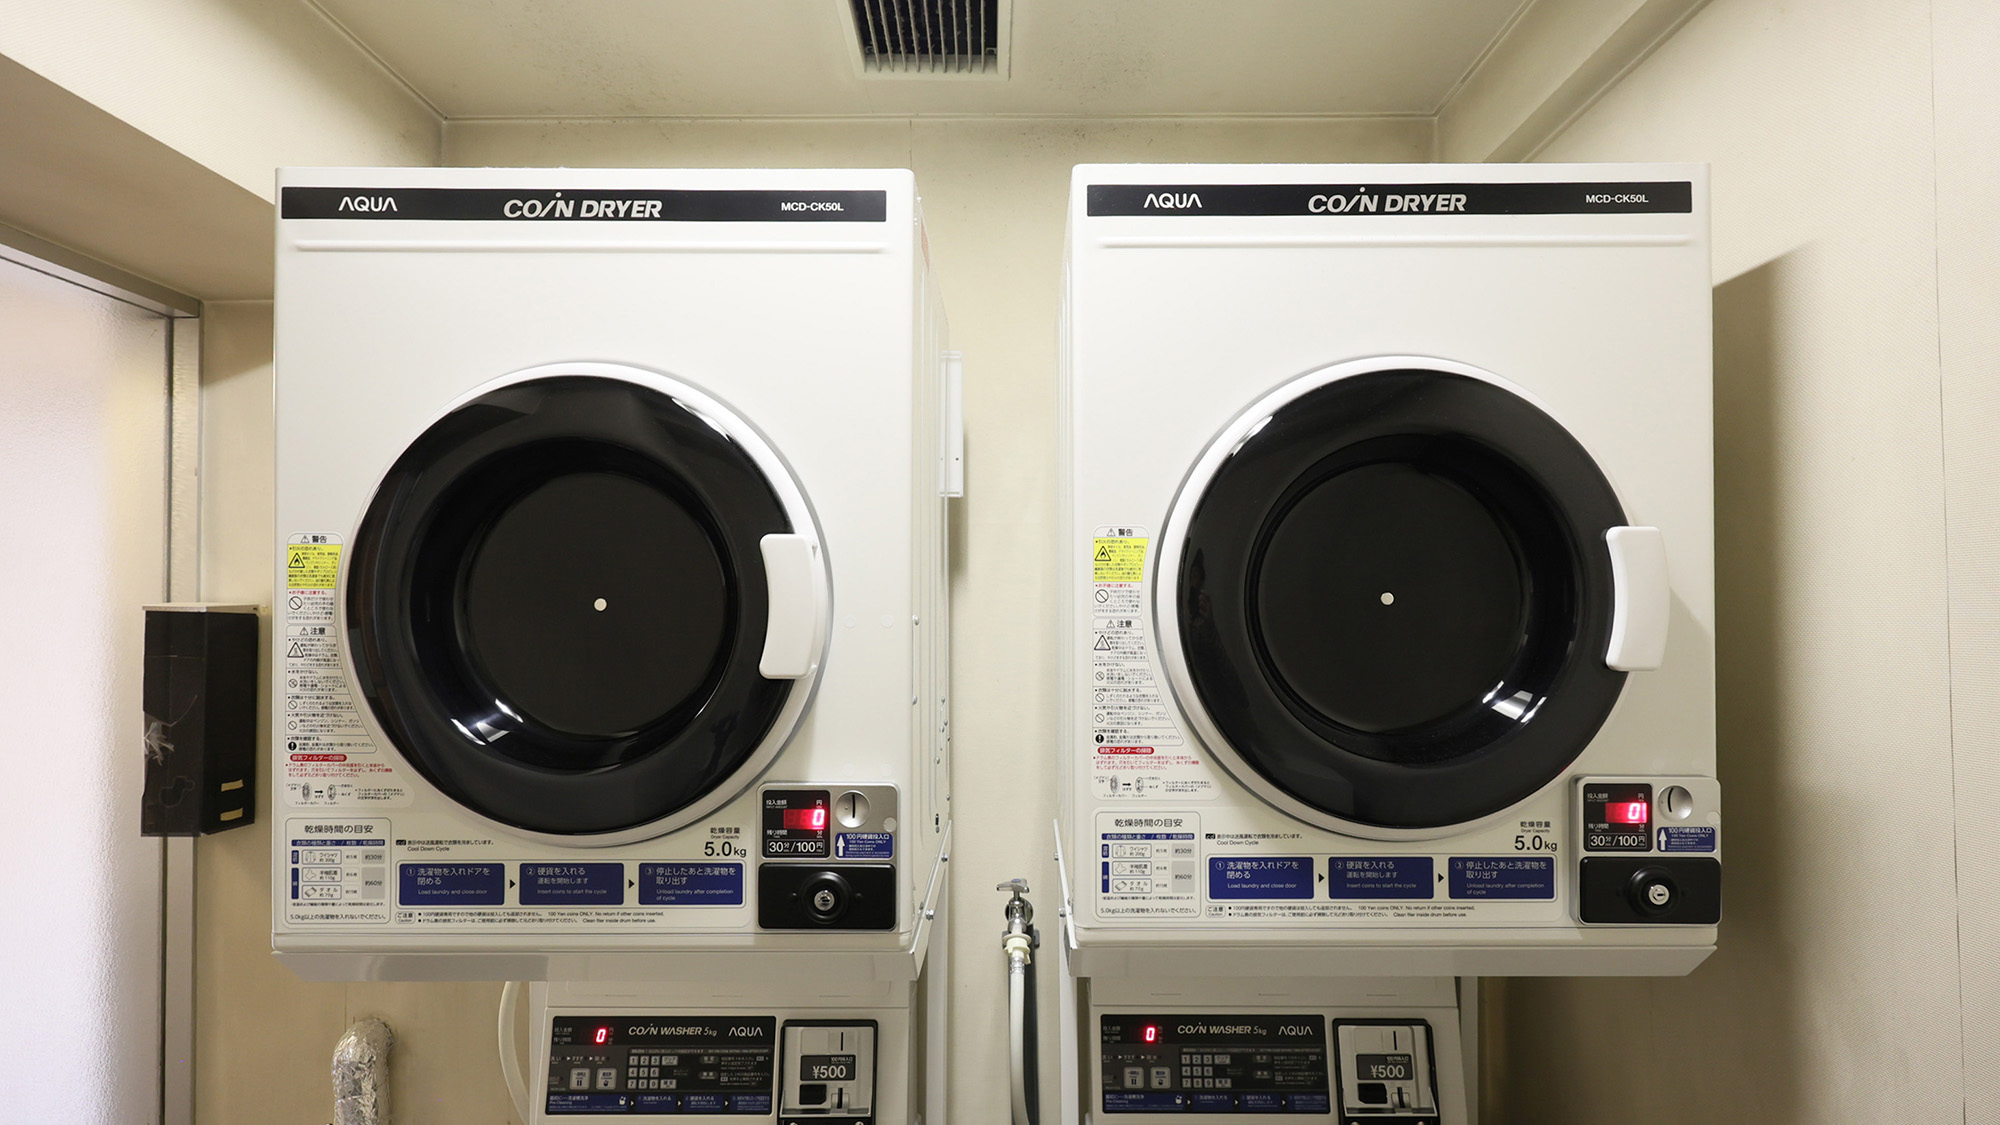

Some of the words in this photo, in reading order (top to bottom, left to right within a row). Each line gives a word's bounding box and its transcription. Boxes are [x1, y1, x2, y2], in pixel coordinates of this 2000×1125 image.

[338, 196, 398, 212] AQUA
[1143, 193, 1203, 209] AQUA
[1307, 186, 1379, 213] COIN
[1384, 194, 1467, 212] DRYER
[1585, 194, 1649, 204] MCD-CK50L
[503, 191, 574, 218] COIN
[579, 200, 663, 218] DRYER
[781, 202, 844, 211] MCD-CK50L
[1118, 528, 1133, 536] 警告
[312, 535, 327, 543] 警告
[1117, 620, 1132, 628] 注意
[310, 627, 326, 635] 注意
[812, 809, 825, 826] 0
[1114, 818, 1183, 828] 乾燥時間の目安
[304, 824, 374, 834] 乾燥時間の目安
[1514, 835, 1557, 852] 5.0kg
[704, 841, 747, 858] 5.0kg
[1227, 861, 1299, 870] 洗濯物を入れドアを
[1346, 861, 1395, 870] 硬貨を入れる
[1466, 861, 1547, 870] 停止したあと洗濯物を
[417, 867, 490, 876] 洗濯物を入れドアを
[537, 867, 586, 876] 硬貨を入れる
[656, 867, 736, 876] 停止したあと洗濯物を
[1227, 870, 1251, 879] 閉める
[1346, 871, 1397, 879] 運転を開始します
[1466, 871, 1498, 880] 取り出す
[417, 876, 442, 885] 閉める
[656, 876, 687, 885] 取り出す
[628, 1023, 657, 1036] COIN
[660, 1026, 702, 1036] WASHER
[728, 1026, 763, 1037] AQUA
[1177, 1022, 1207, 1034] COIN
[1209, 1025, 1252, 1034] WASHER
[1278, 1025, 1313, 1036] AQUA
[596, 1028, 607, 1043] 0
[1145, 1027, 1156, 1042] 0
[813, 1065, 846, 1079] ¥500
[1371, 1065, 1405, 1079] ¥500
